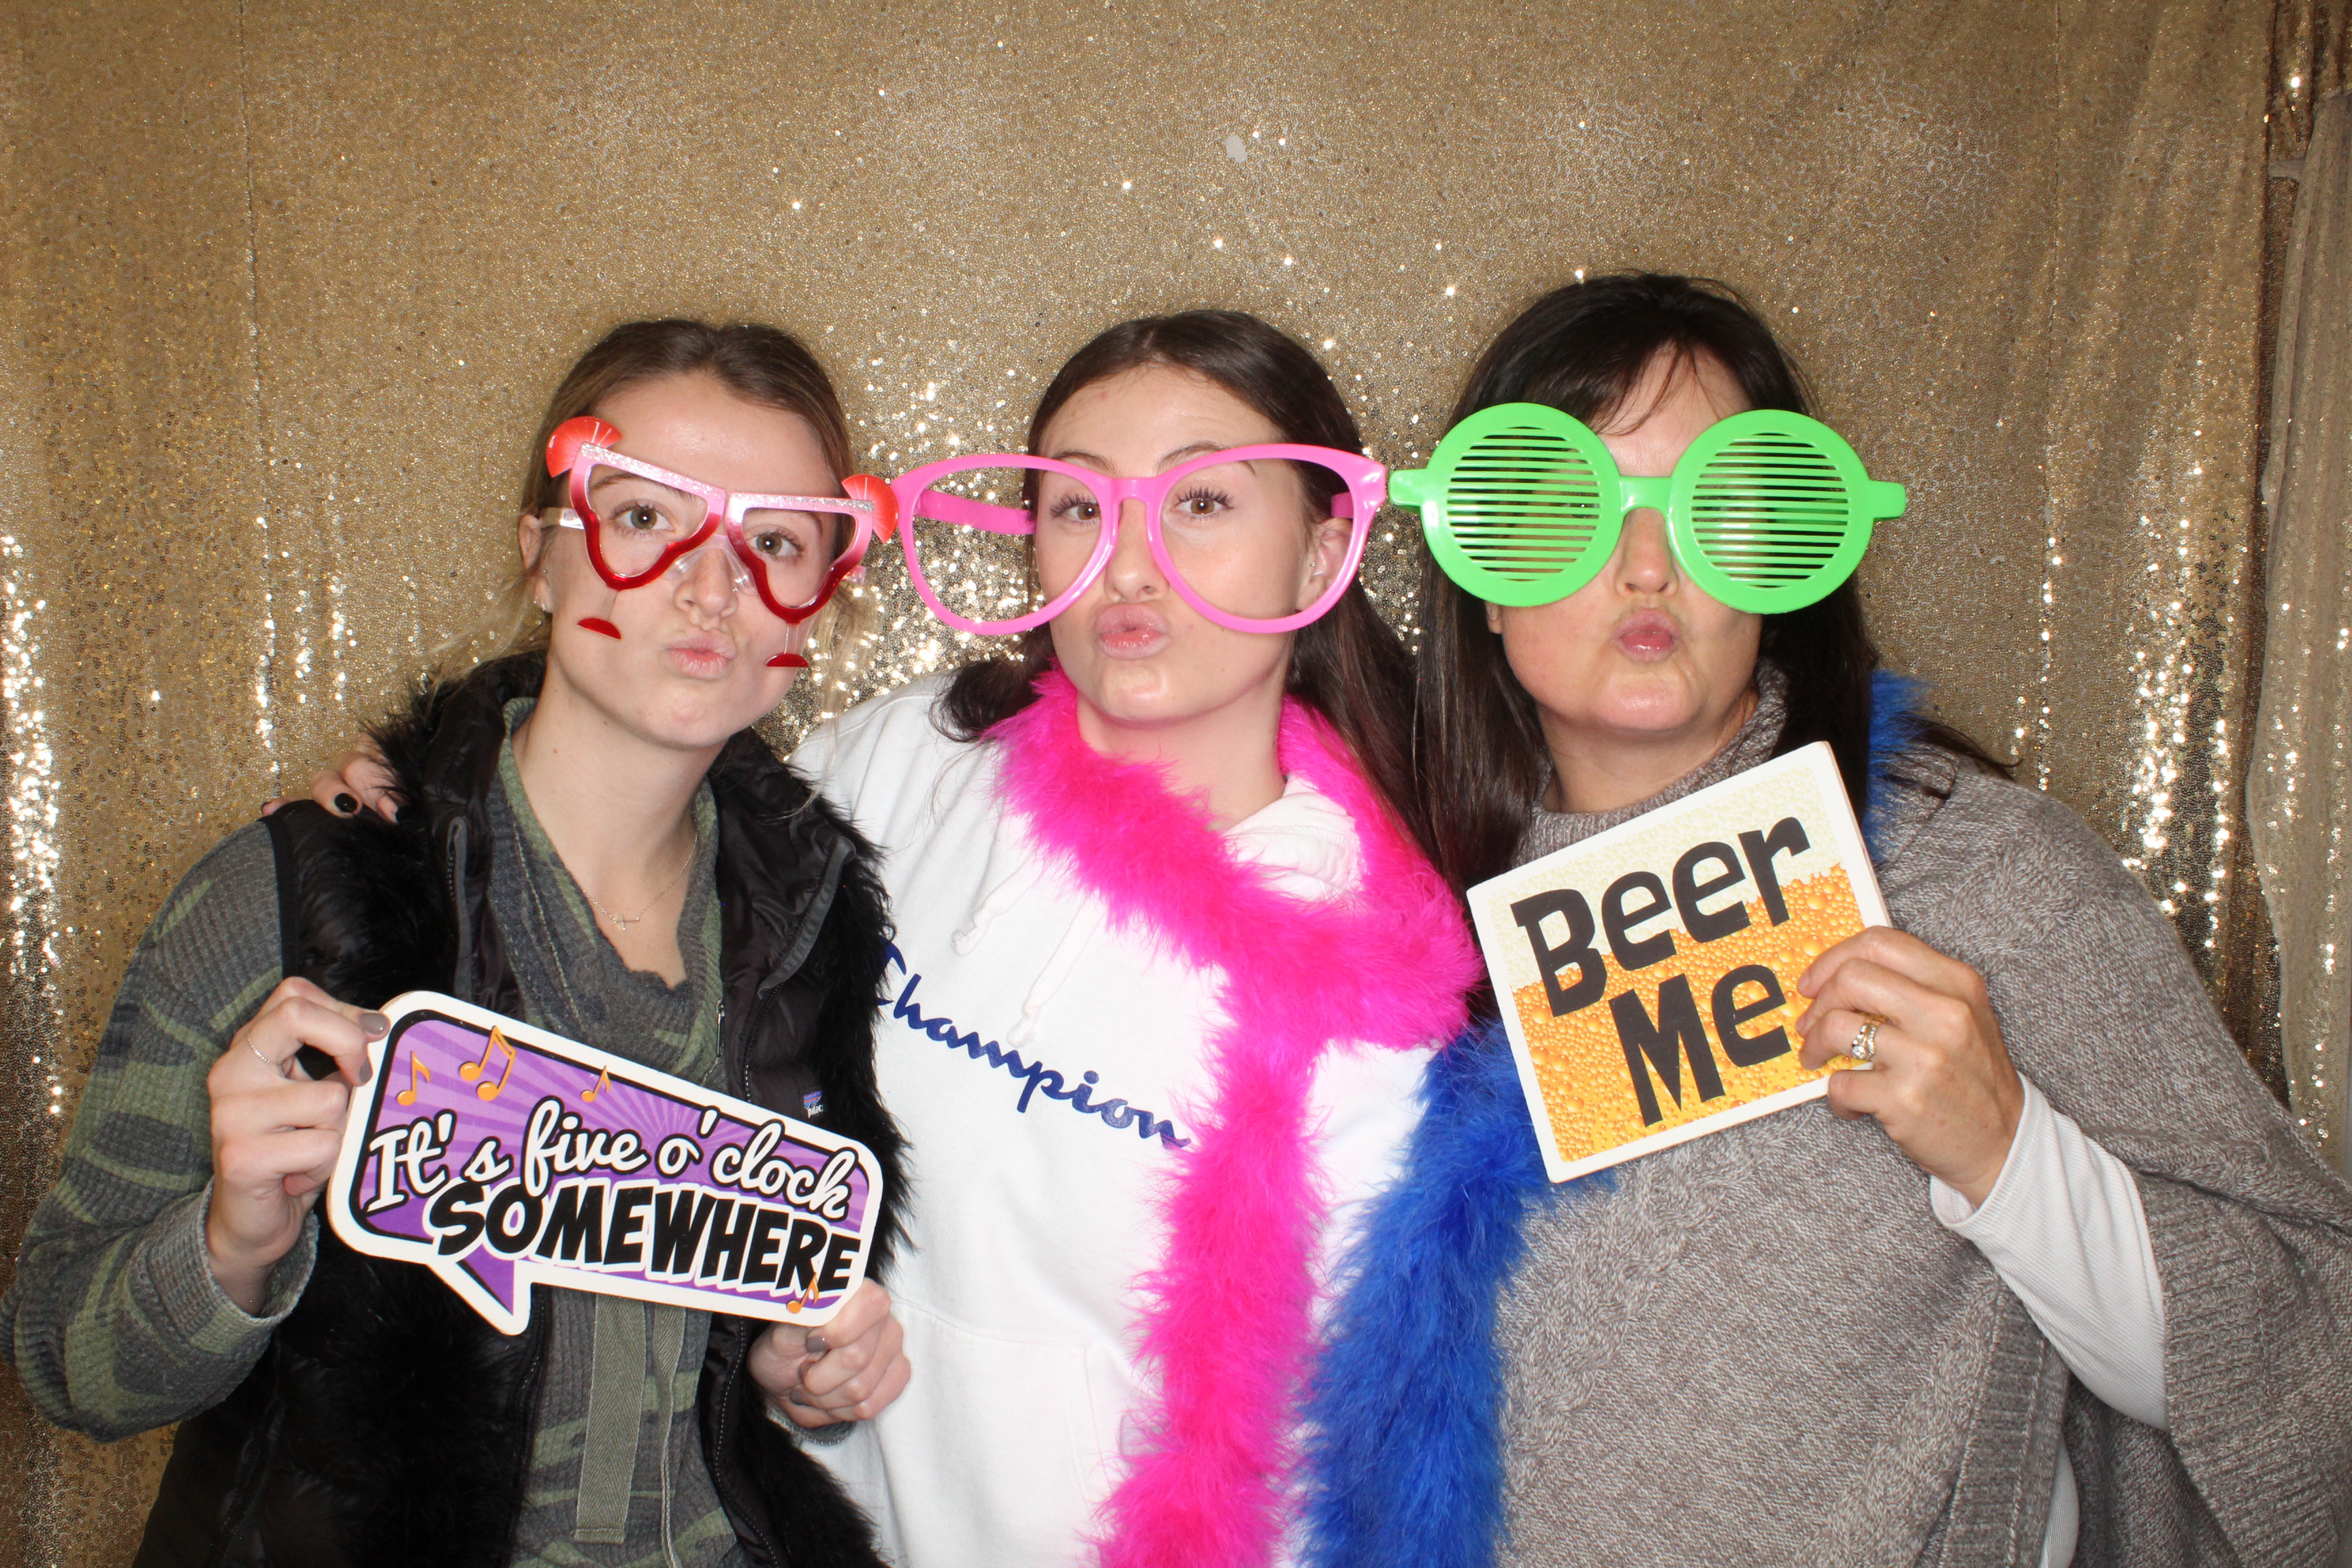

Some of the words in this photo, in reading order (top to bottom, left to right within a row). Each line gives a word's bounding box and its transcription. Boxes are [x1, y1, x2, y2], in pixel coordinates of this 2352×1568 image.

[1510, 817, 1810, 1017] Beer
[1607, 964, 1793, 1128] Me
[364, 1111, 510, 1213] It's
[525, 1099, 647, 1198] five
[660, 1108, 851, 1217] o'clock
[429, 1182, 861, 1292] SOMEWHERE
